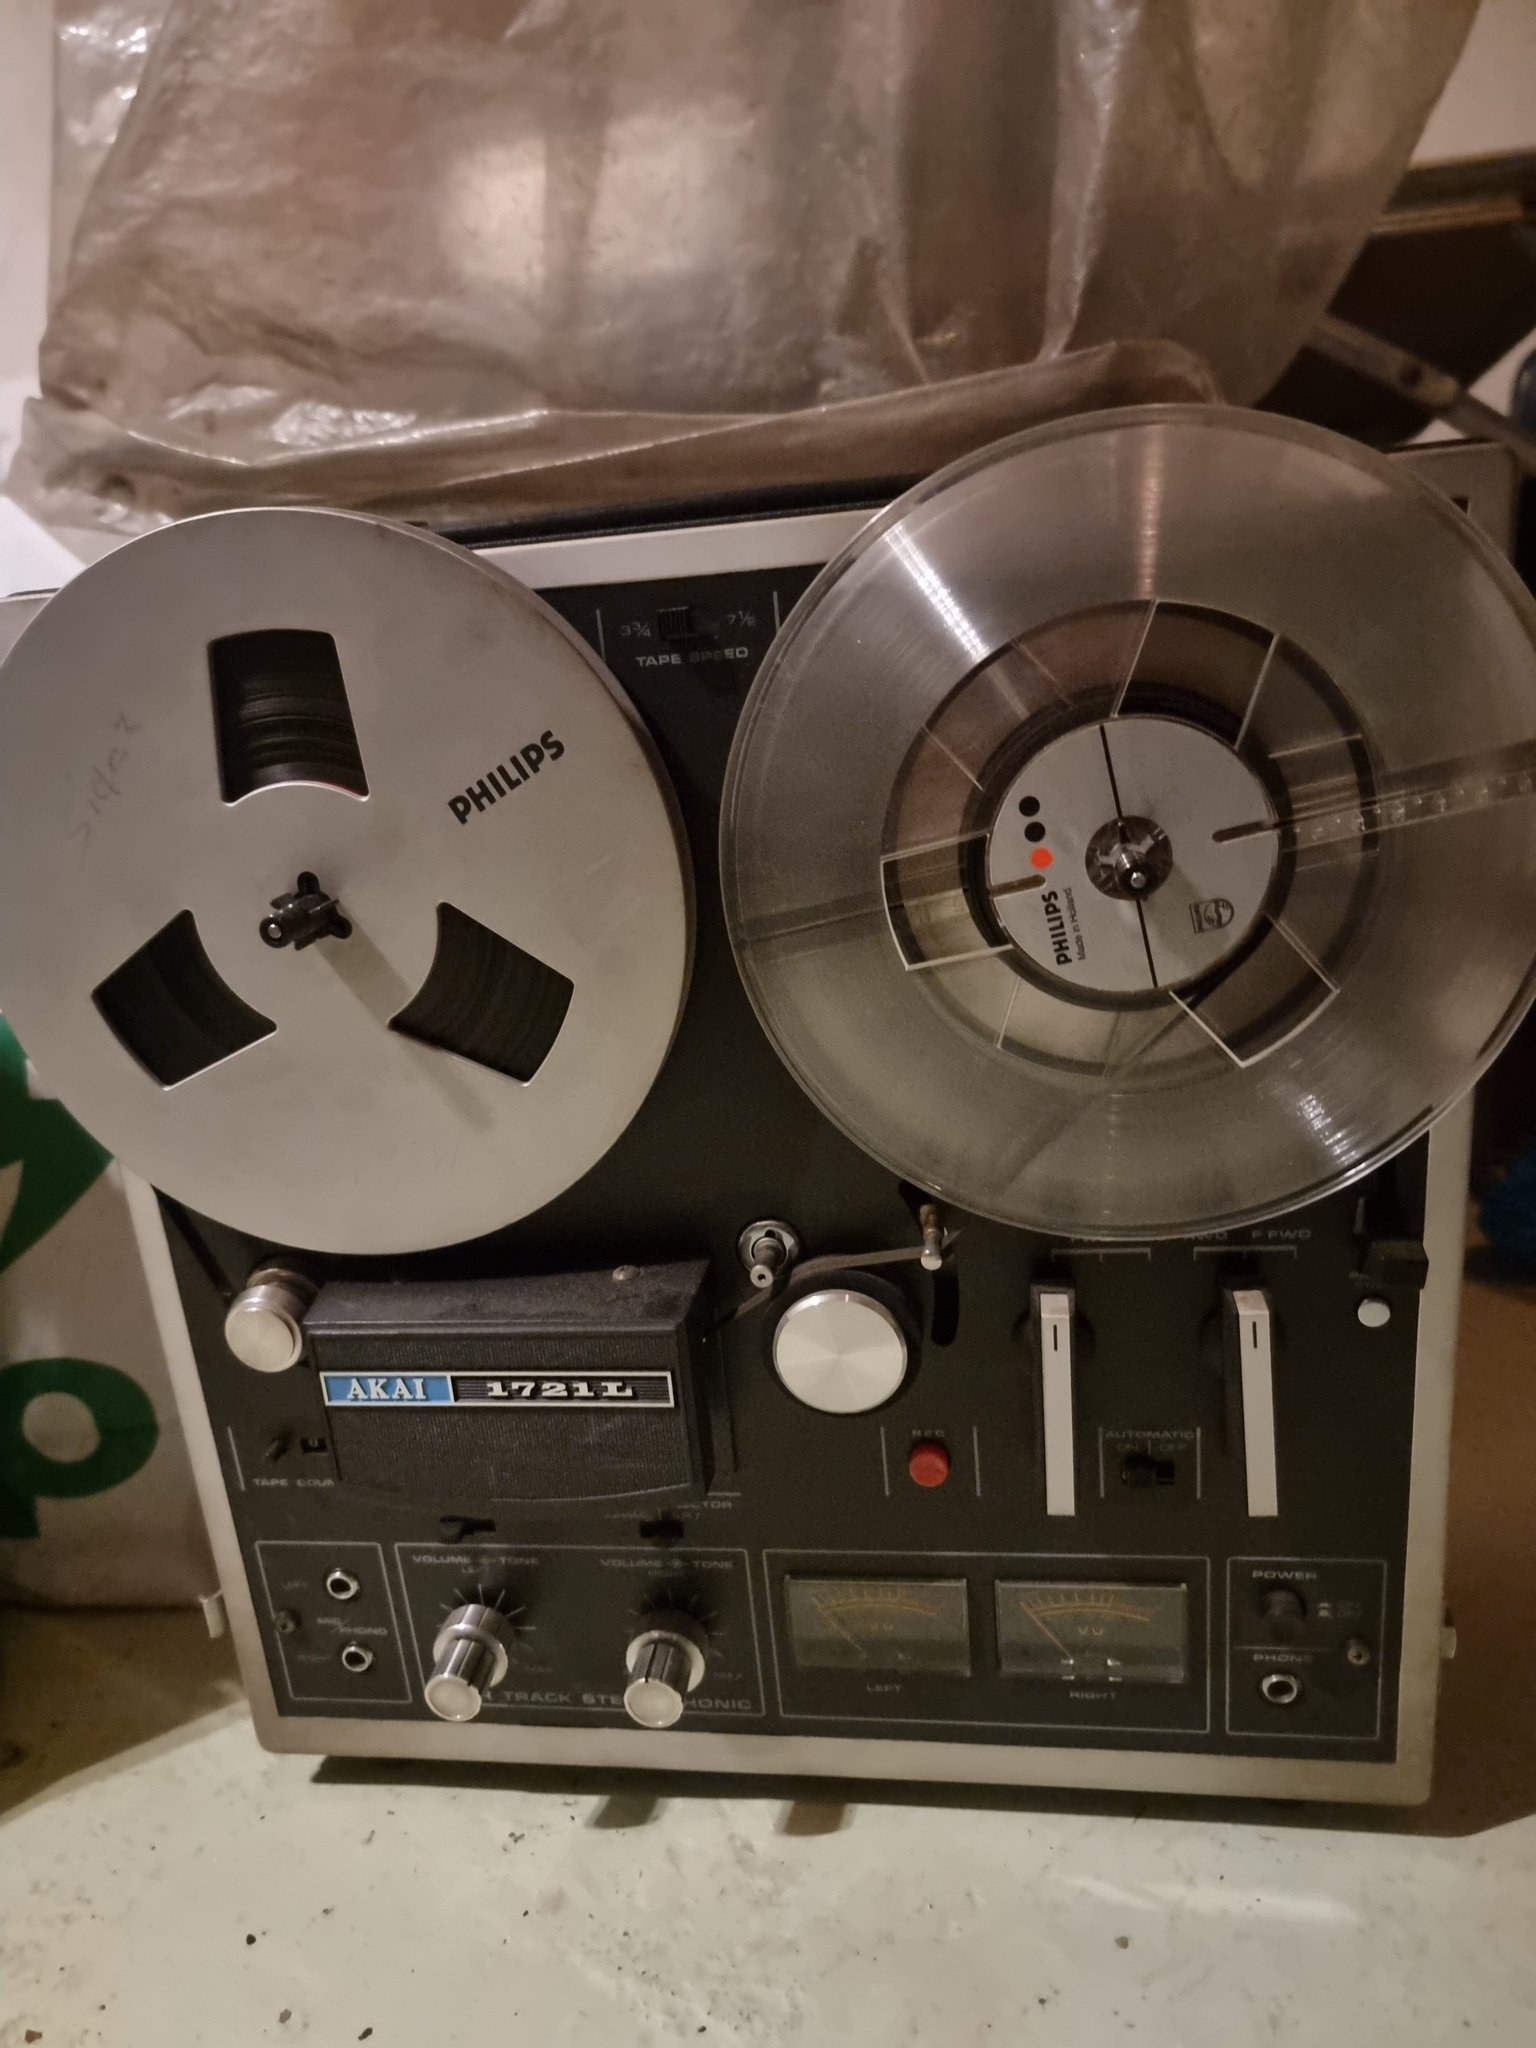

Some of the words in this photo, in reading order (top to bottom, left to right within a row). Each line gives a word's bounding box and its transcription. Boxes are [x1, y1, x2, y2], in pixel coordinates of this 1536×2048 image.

[635, 653, 682, 667] TAPE
[688, 646, 749, 664] SPEED
[447, 729, 566, 825] PHILIPS
[1041, 890, 1073, 966] PHILIPS
[346, 1377, 427, 1401] AKAI
[486, 1380, 634, 1398] 1721L
[1105, 1429, 1195, 1440] AUTOMATIC
[252, 1477, 288, 1487] TAPE
[411, 1553, 471, 1565] VOLUME
[498, 1555, 540, 1565] TONE
[600, 1558, 664, 1568] VOLUME
[692, 1559, 734, 1569] TONE
[1251, 1569, 1318, 1581] POWER
[503, 1691, 572, 1703] TRACK
[1069, 1690, 1118, 1700] RIGHT
